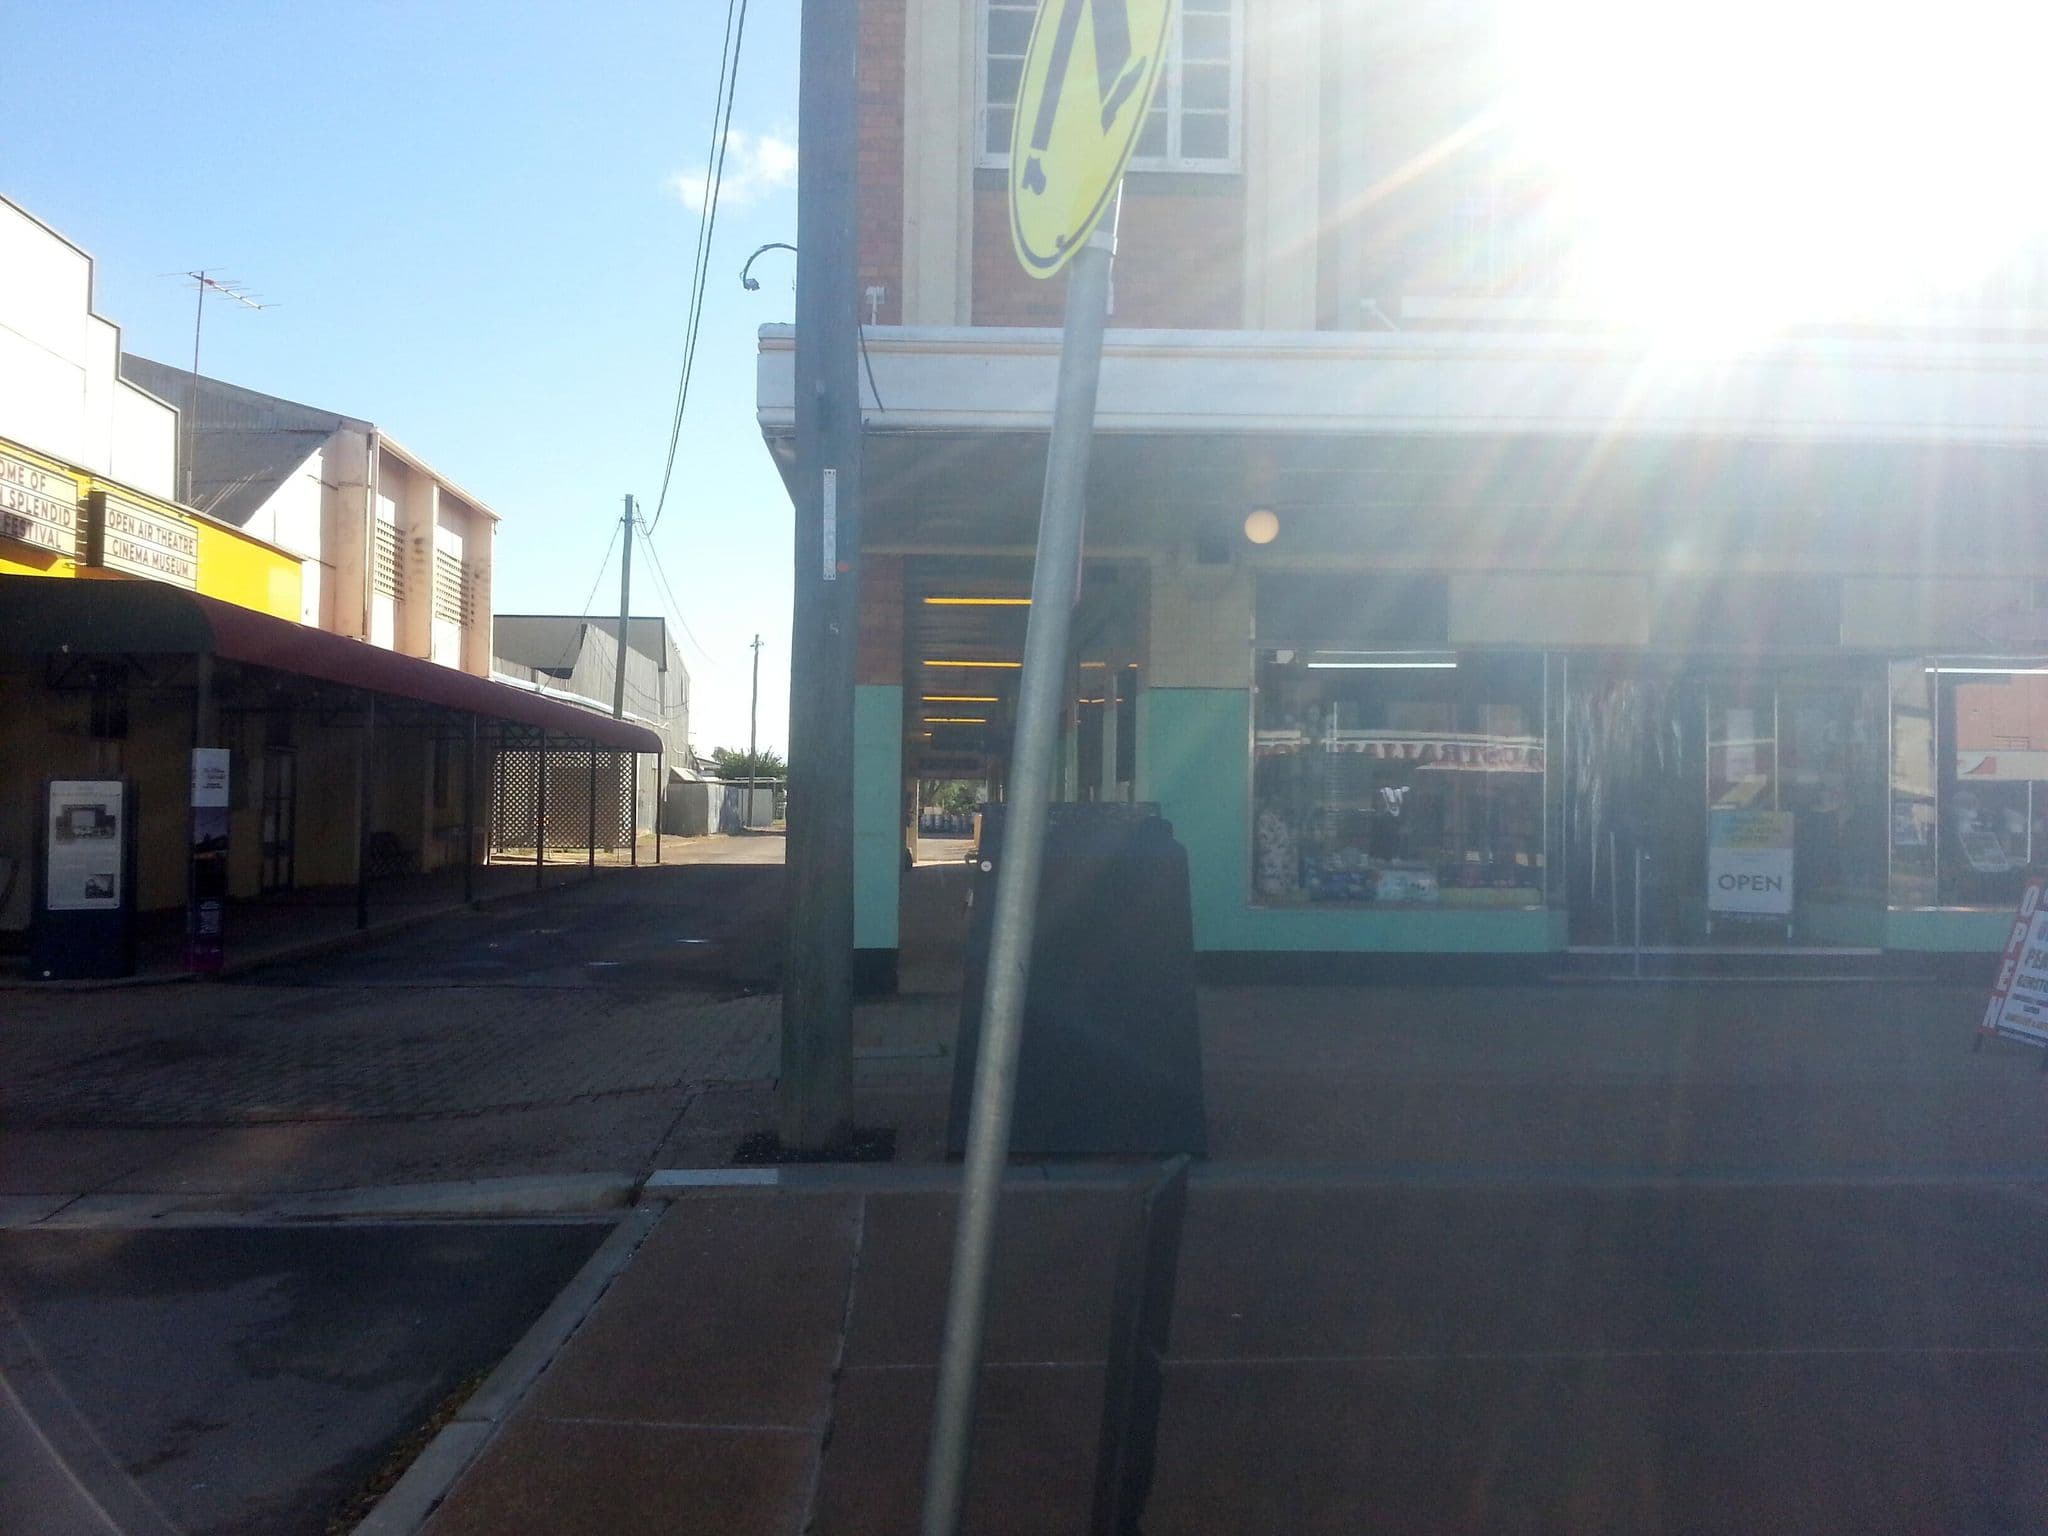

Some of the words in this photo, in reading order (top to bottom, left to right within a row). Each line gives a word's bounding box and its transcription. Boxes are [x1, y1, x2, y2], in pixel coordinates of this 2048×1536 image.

[30, 472, 46, 490] OF
[9, 490, 71, 526] SPLENDID
[4, 514, 61, 548] FESTIVAL
[108, 510, 134, 533] OPEN
[138, 521, 153, 540] AIR
[157, 528, 193, 555] THEATRE
[112, 539, 149, 565] CINEMA
[152, 552, 189, 576] MUSEUM
[1718, 874, 1782, 892] OPEN
